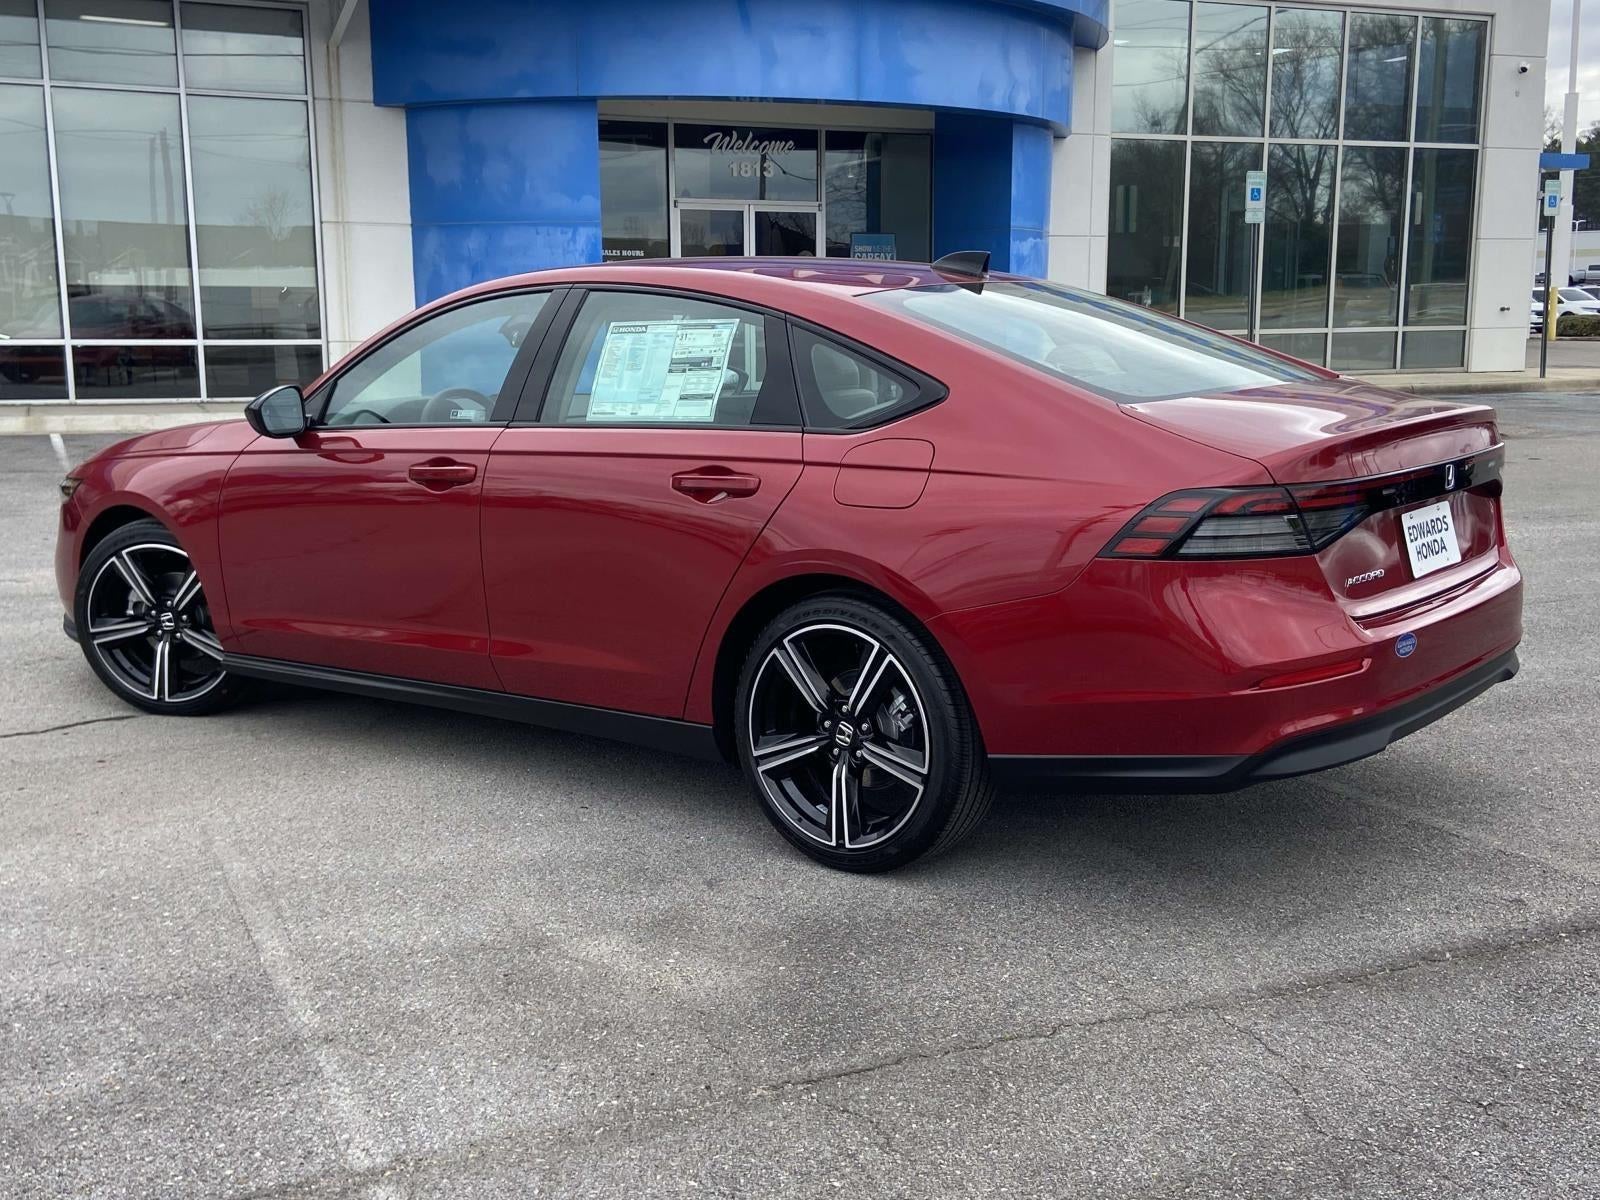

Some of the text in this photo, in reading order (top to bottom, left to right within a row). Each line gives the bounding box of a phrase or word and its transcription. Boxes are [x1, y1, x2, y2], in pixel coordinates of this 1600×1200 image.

[703, 130, 796, 155] Welcome
[729, 160, 774, 177] 1813
[621, 249, 645, 257] HOURS
[619, 325, 647, 333] HONDA
[1407, 514, 1449, 543] EDWARDS
[1415, 536, 1448, 561] HONDA
[1345, 568, 1385, 588] ACCORD
